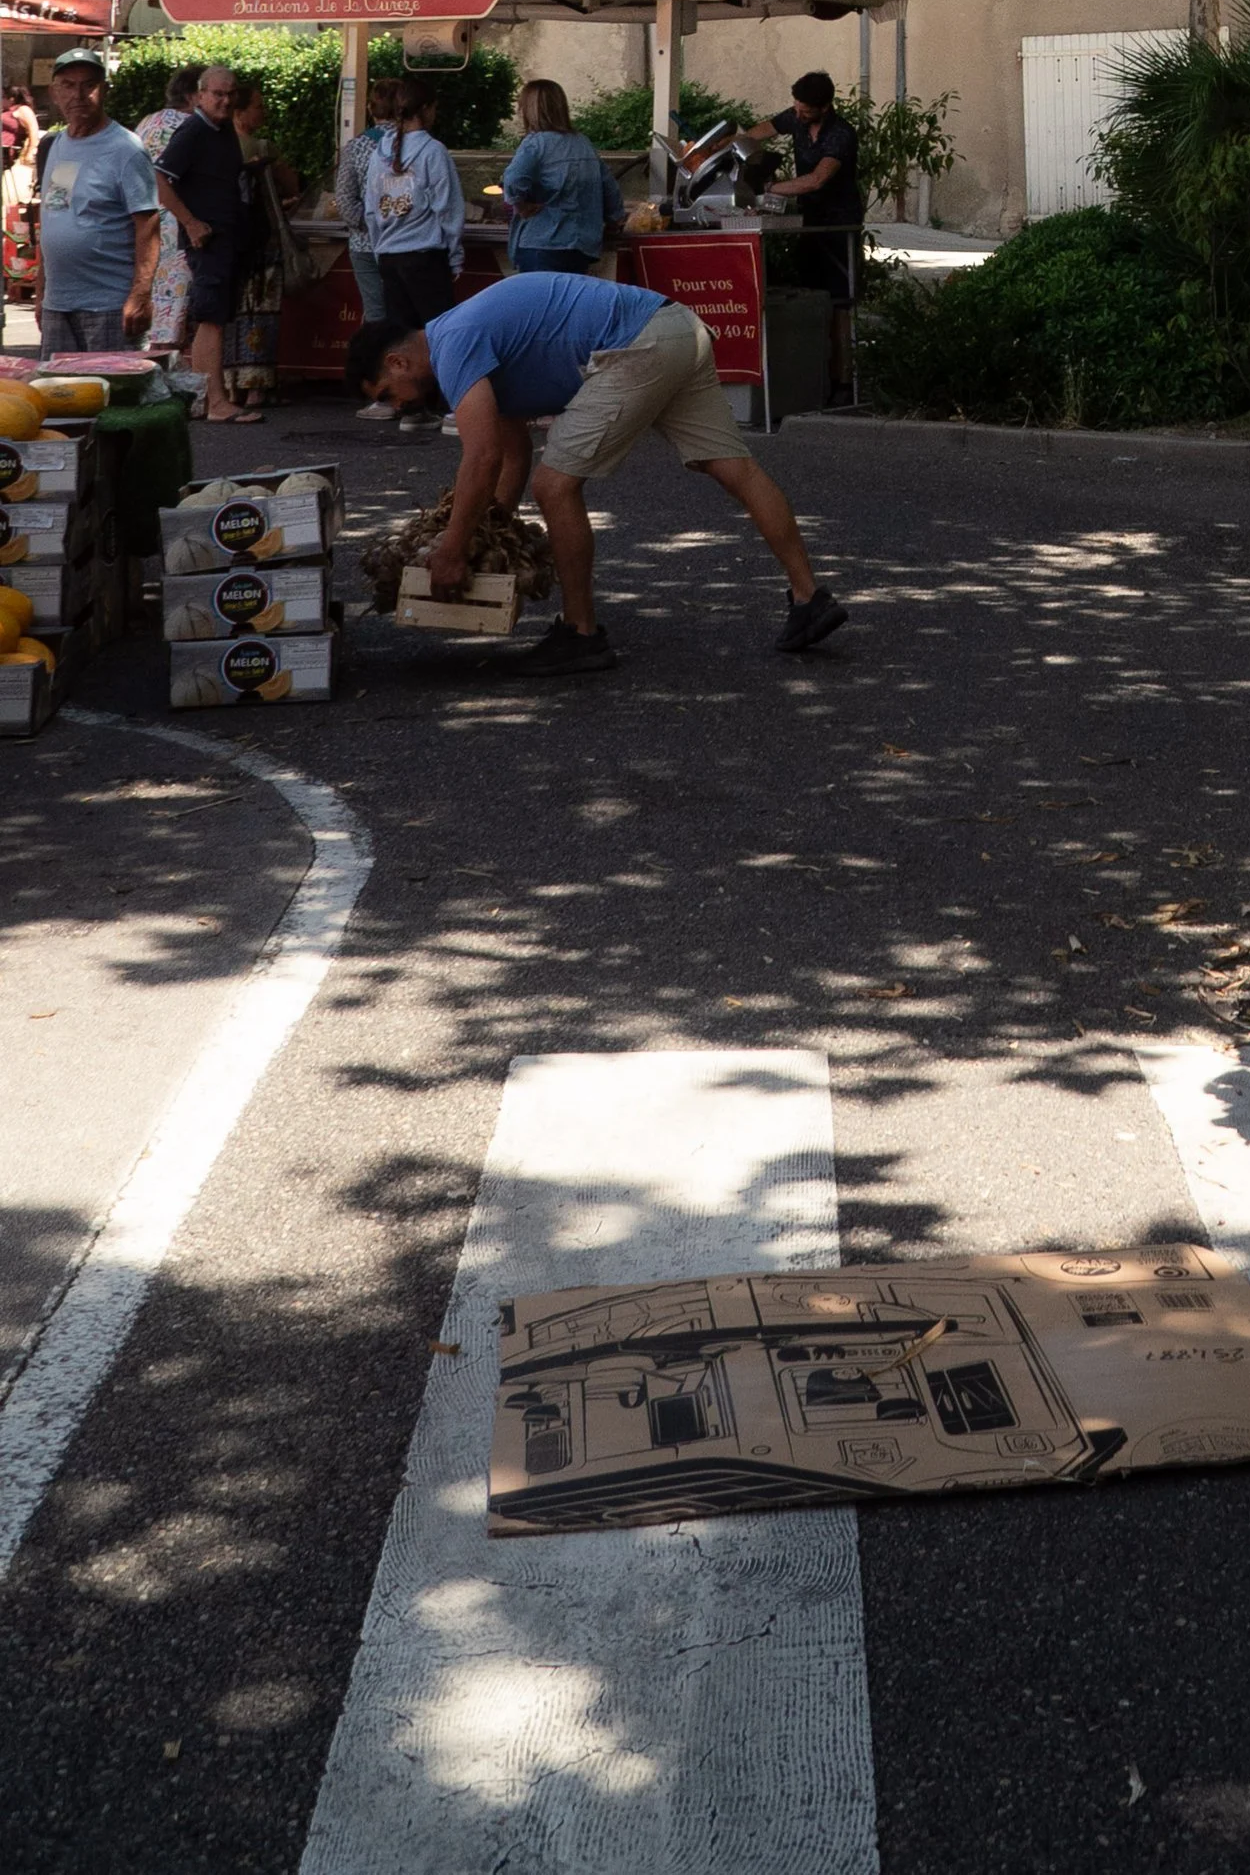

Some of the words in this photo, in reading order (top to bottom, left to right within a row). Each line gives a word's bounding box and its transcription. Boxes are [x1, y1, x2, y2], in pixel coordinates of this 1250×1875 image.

[672, 278, 706, 293] Pour
[709, 278, 734, 291] vos
[724, 324, 741, 339] 40
[743, 325, 756, 340] 47
[219, 516, 260, 531] MELON
[222, 589, 262, 601] MELON
[229, 657, 270, 669] MELON
